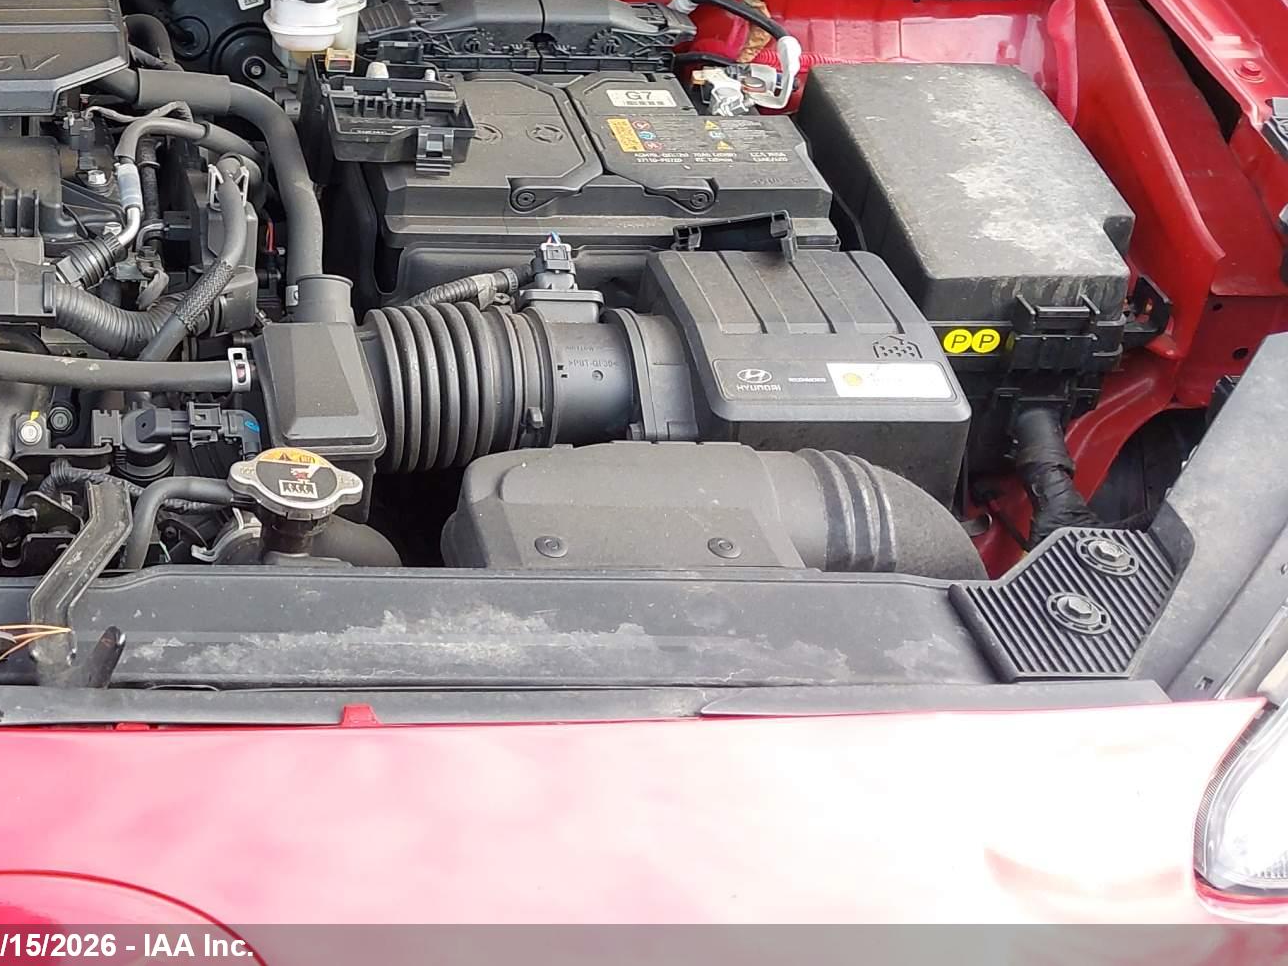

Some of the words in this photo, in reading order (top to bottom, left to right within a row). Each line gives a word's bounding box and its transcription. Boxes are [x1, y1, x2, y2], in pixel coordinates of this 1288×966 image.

[625, 90, 653, 101] G7
[951, 334, 967, 349] P
[978, 334, 995, 349] P
[736, 384, 781, 392] HYUNDAI
